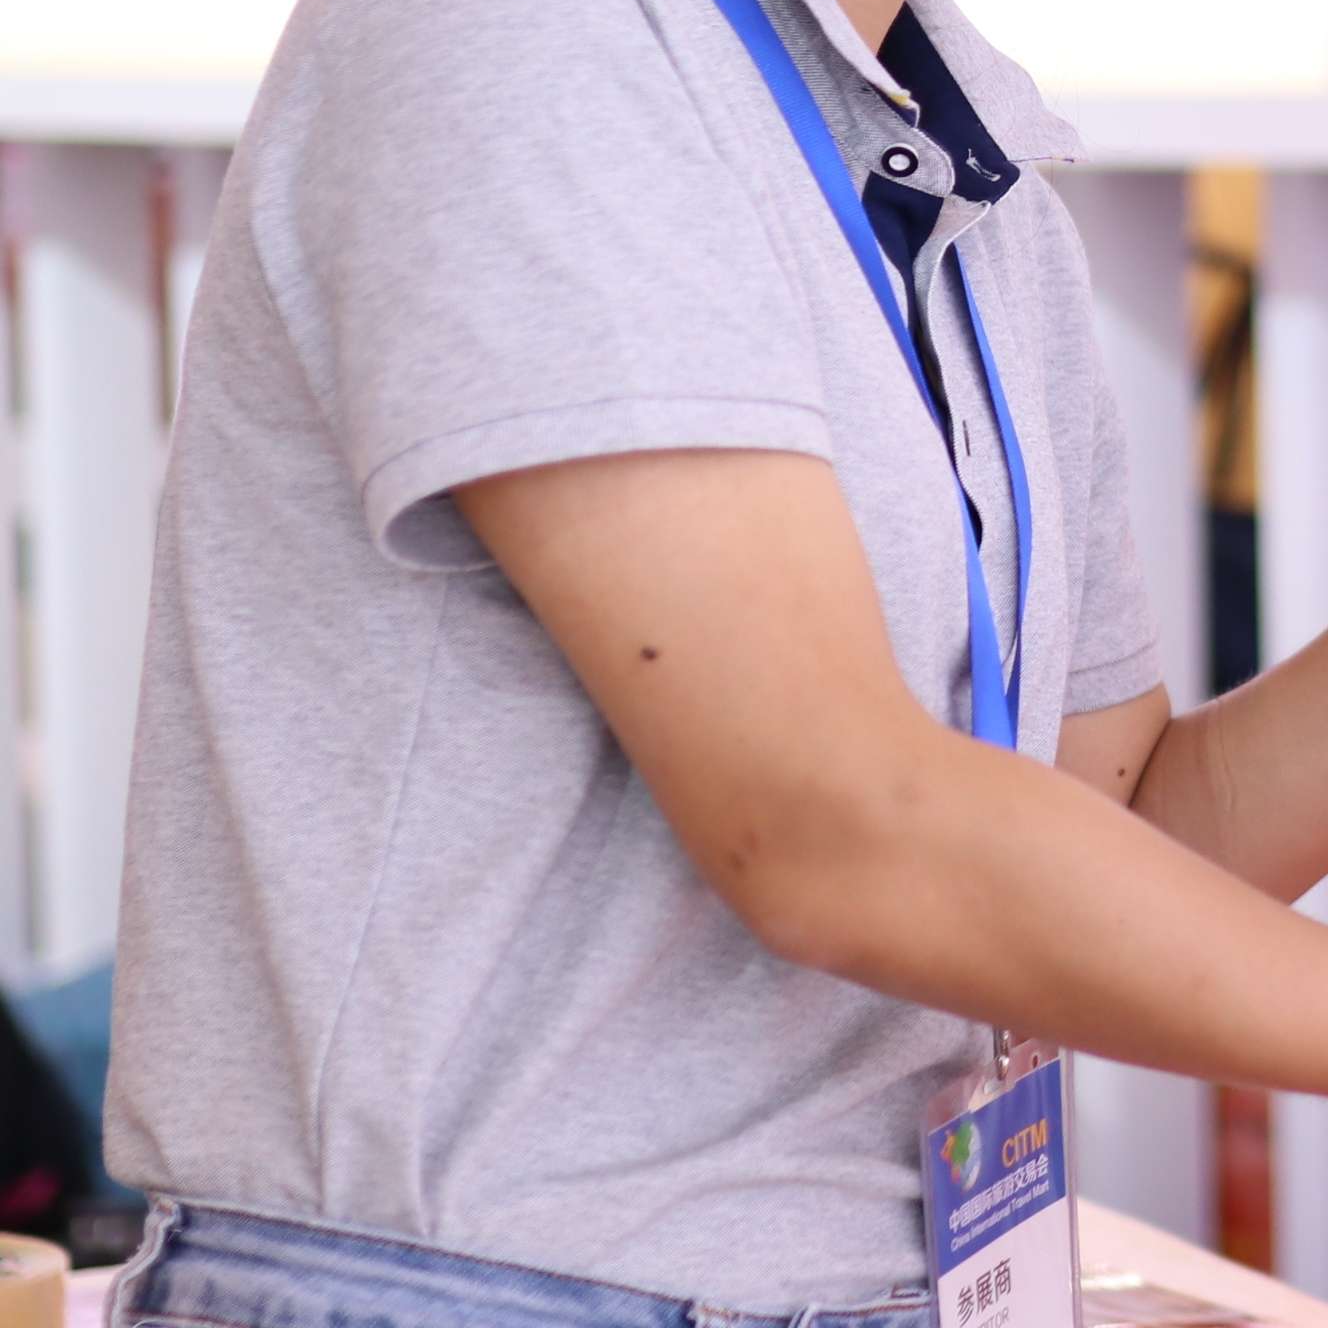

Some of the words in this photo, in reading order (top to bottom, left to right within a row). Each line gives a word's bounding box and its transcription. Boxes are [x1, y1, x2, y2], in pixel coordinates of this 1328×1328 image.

[1002, 1119, 1048, 1168] CITM
[957, 1258, 1011, 1327] 参展商
